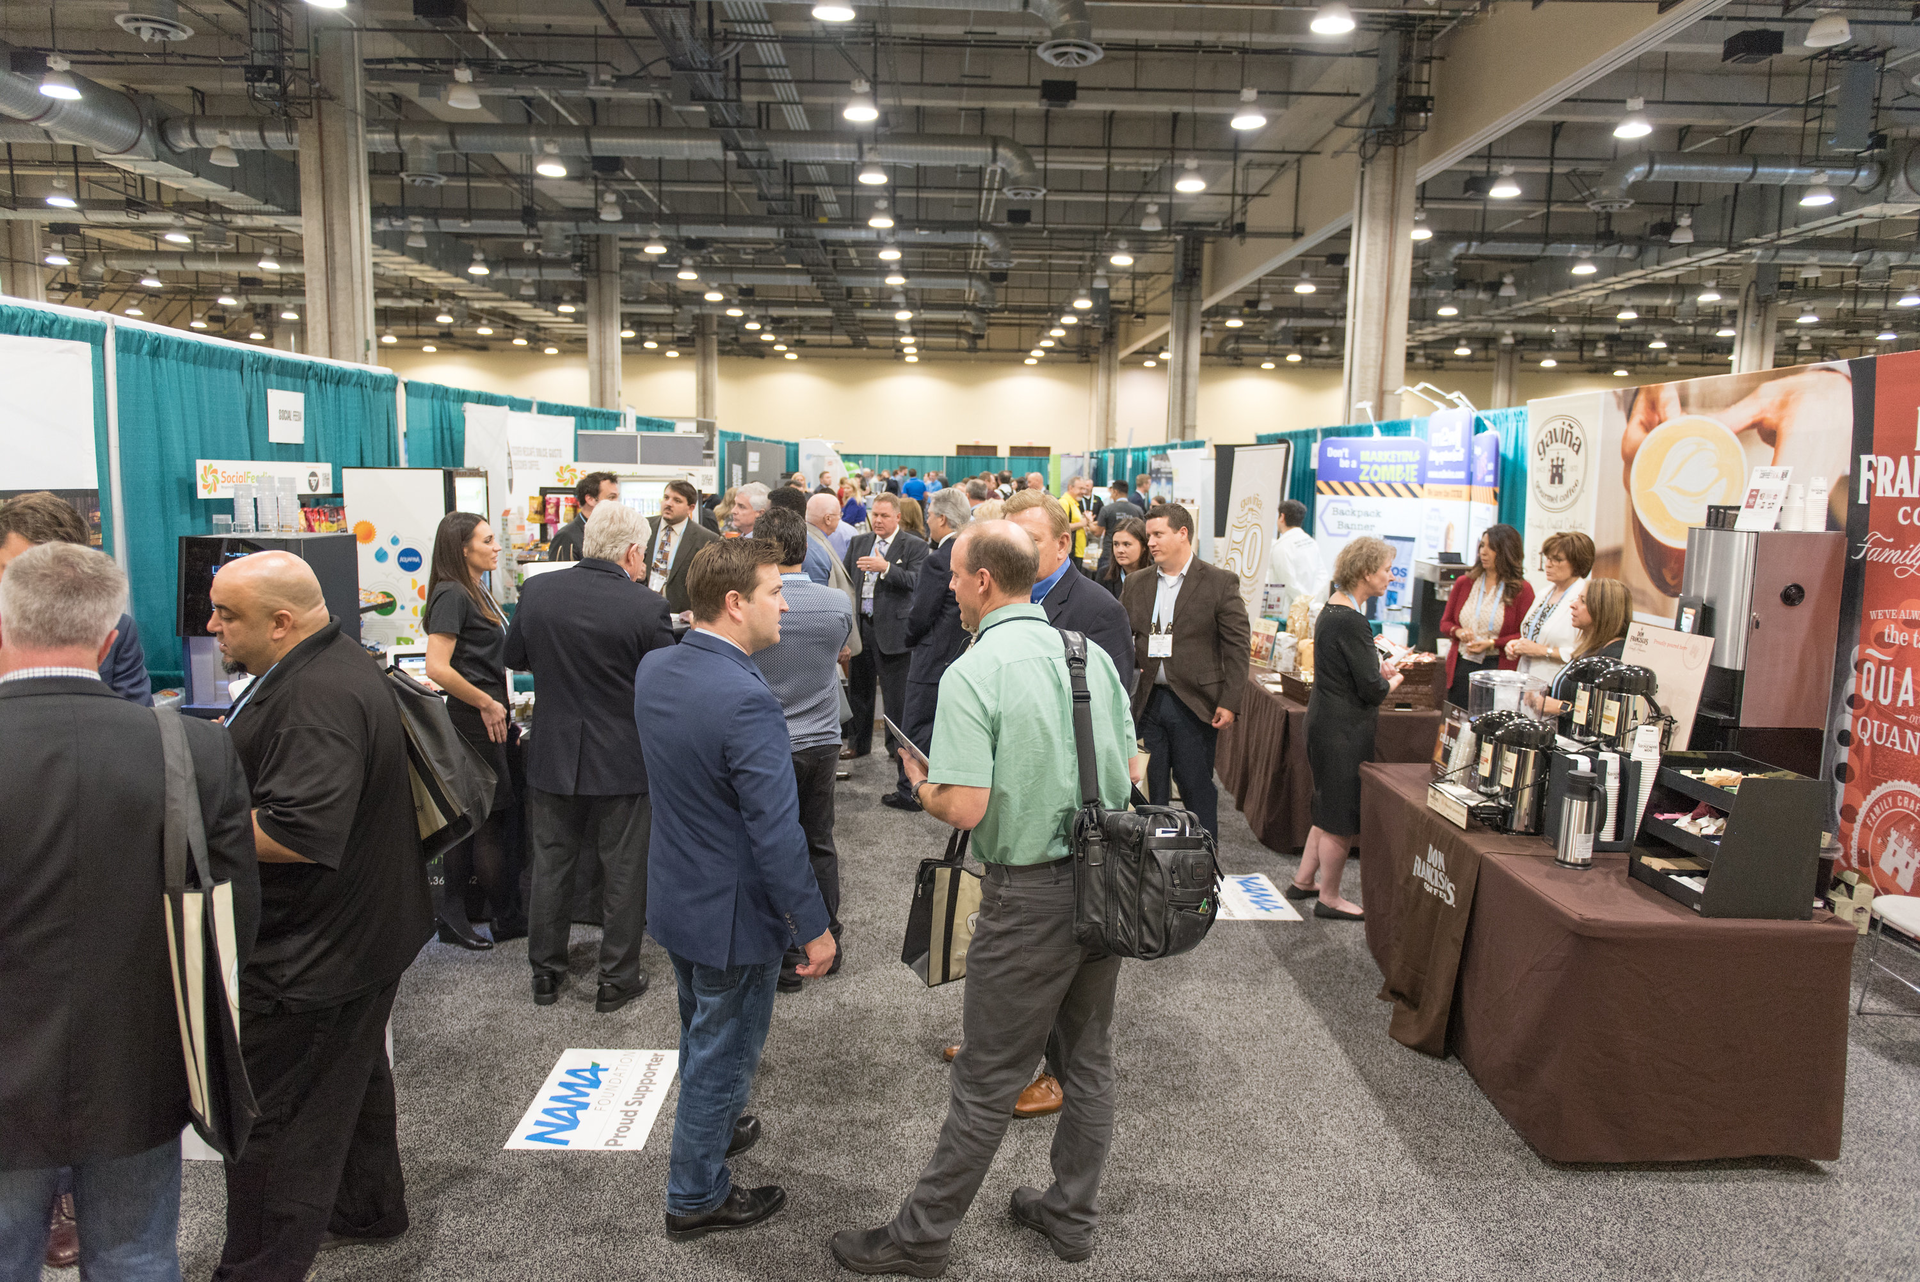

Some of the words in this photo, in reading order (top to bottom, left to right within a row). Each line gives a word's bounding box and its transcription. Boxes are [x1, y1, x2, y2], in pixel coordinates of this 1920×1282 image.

[278, 409, 292, 421] SOCIAL
[1537, 421, 1582, 461] gaviña
[1327, 447, 1349, 458] Don't
[1360, 450, 1420, 463] MARKETING
[1359, 464, 1418, 482] ZOMBIE
[1332, 507, 1382, 518] Backpack
[1337, 521, 1375, 531] Banner
[1869, 609, 1898, 620] WE'VE
[1884, 624, 1909, 646] the
[1866, 797, 1893, 828] FAMILY
[1427, 843, 1446, 872] DON
[1231, 876, 1284, 911] NAMA
[594, 1050, 637, 1112] FOUNDATION
[525, 1061, 611, 1146] NAMA
[604, 1109, 640, 1147] Proud
[624, 1052, 665, 1107] Supporter
